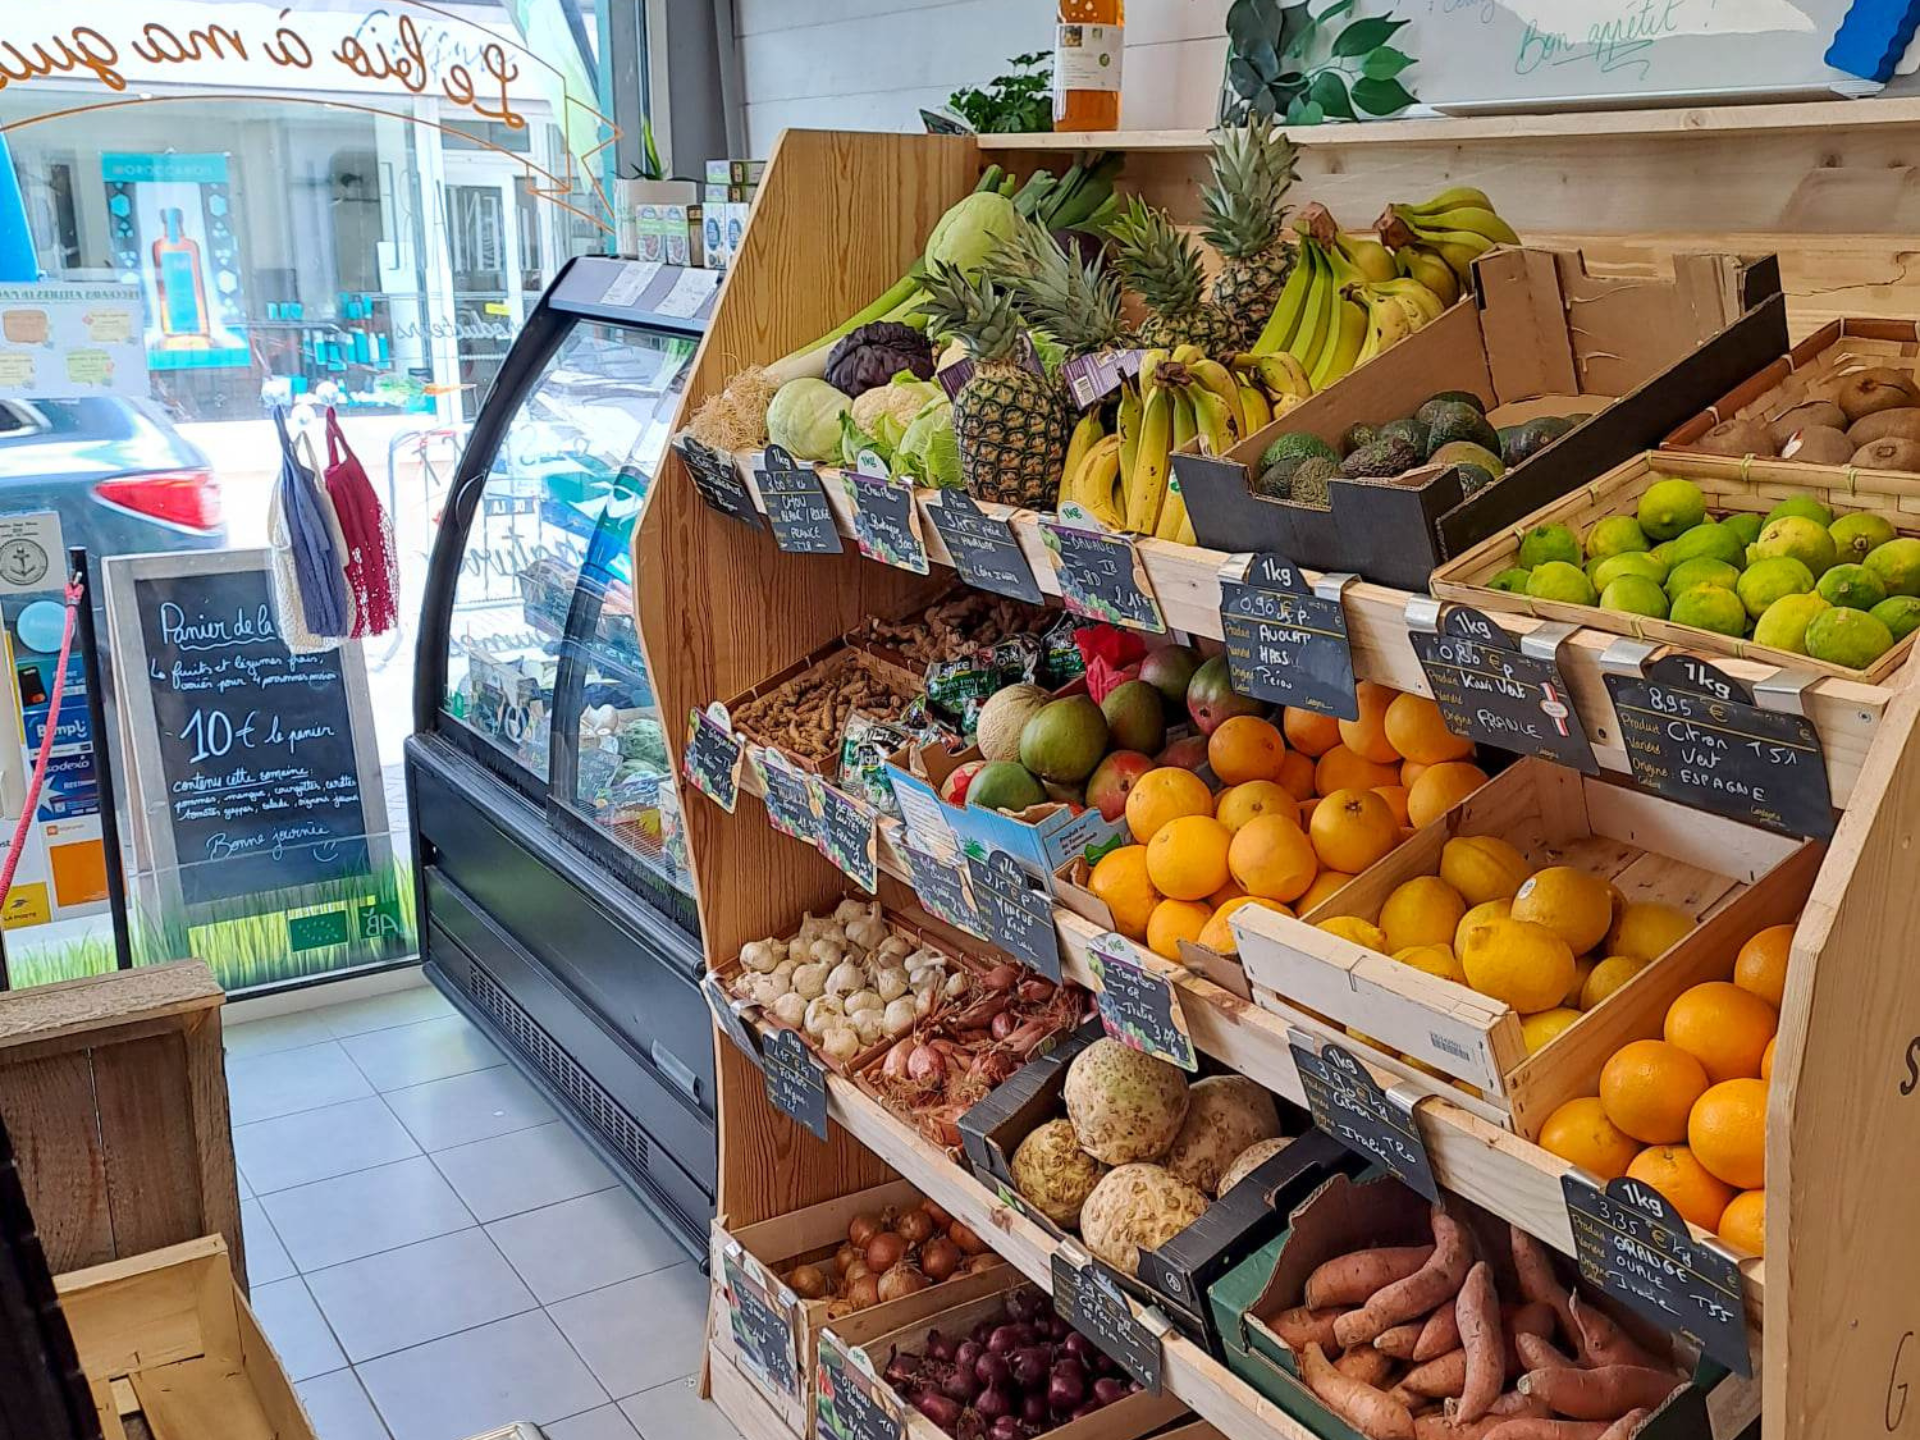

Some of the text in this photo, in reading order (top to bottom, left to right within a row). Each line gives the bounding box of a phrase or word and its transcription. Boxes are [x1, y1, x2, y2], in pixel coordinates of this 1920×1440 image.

[1515, 19, 1575, 75] Bon
[1261, 557, 1292, 587] 1kg
[161, 602, 275, 645] Panier de la
[1259, 623, 1312, 646] AVOCAT
[1454, 611, 1492, 640] 1kg
[1259, 644, 1290, 665] HASS
[171, 661, 213, 690] fruits
[1684, 662, 1732, 701] 1kg
[36, 720, 89, 738] Bmpli
[287, 721, 335, 754] panier
[1667, 721, 1729, 751] Citron
[1680, 748, 1722, 769] Vert
[172, 772, 223, 794] contenu
[225, 768, 257, 786] cette
[1680, 769, 1767, 803] ESPAGNE
[206, 821, 331, 861] Bonne journée
[1328, 1048, 1358, 1075] 1kg
[1621, 1183, 1664, 1218] 1kg
[1612, 1235, 1688, 1284] ORANGE
